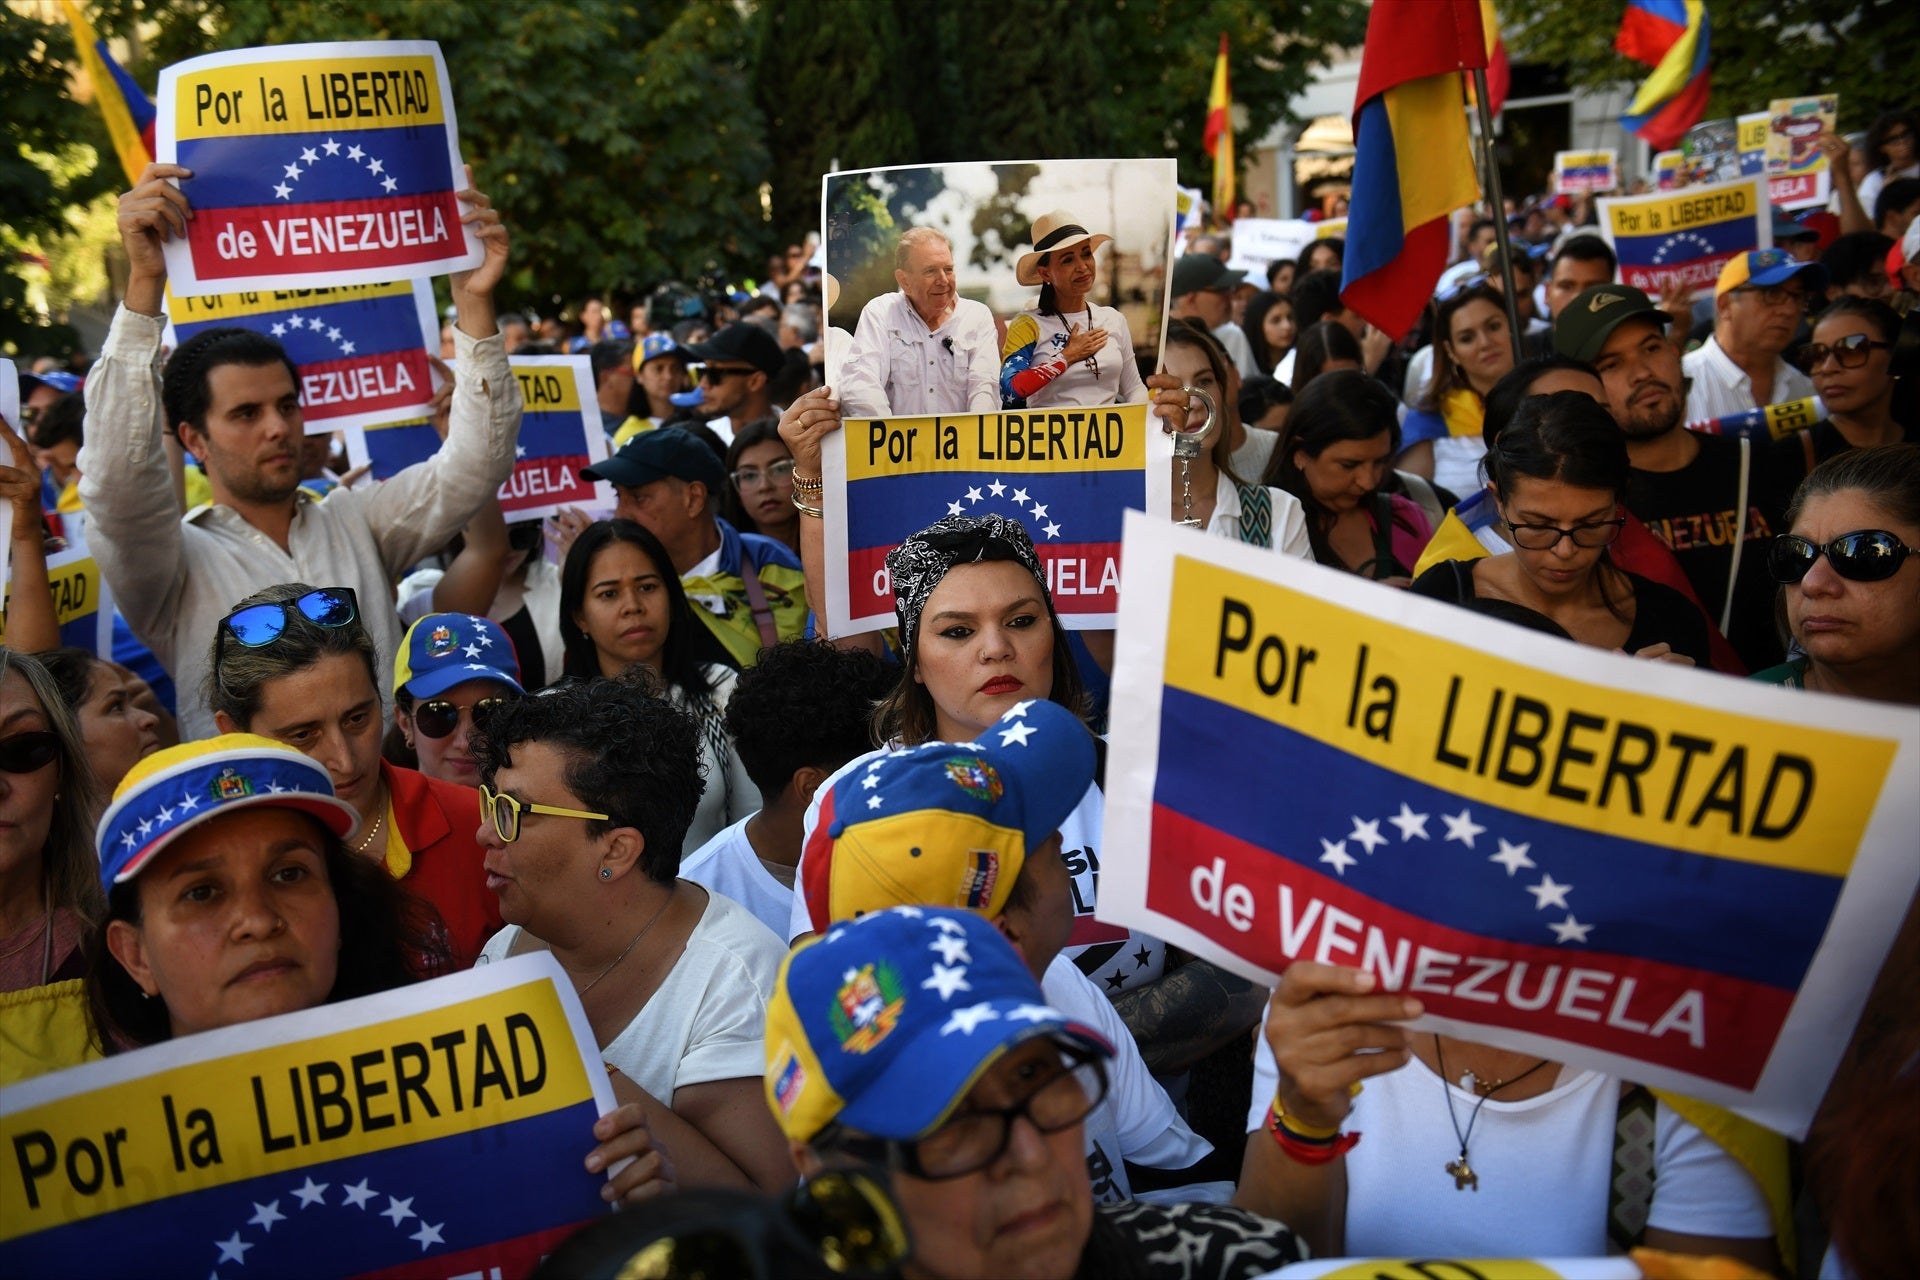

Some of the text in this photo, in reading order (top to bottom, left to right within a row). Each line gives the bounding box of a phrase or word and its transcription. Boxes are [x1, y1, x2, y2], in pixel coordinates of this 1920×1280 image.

[196, 70, 430, 126] Por la LIBERTAD
[217, 206, 449, 260] de VENEZUELA
[1618, 191, 1746, 231] Por la LIBERTAD
[1649, 258, 1729, 289] VENEZUE
[298, 362, 415, 407] EZUELA
[869, 413, 1124, 465] Por la LIBERTAD
[497, 465, 577, 499] ZUELA
[1214, 597, 1817, 841] Por la LIBERTAD
[1189, 857, 1705, 1048] de VENEZUELA
[11, 1012, 548, 1211] Por la LIBERTAD
